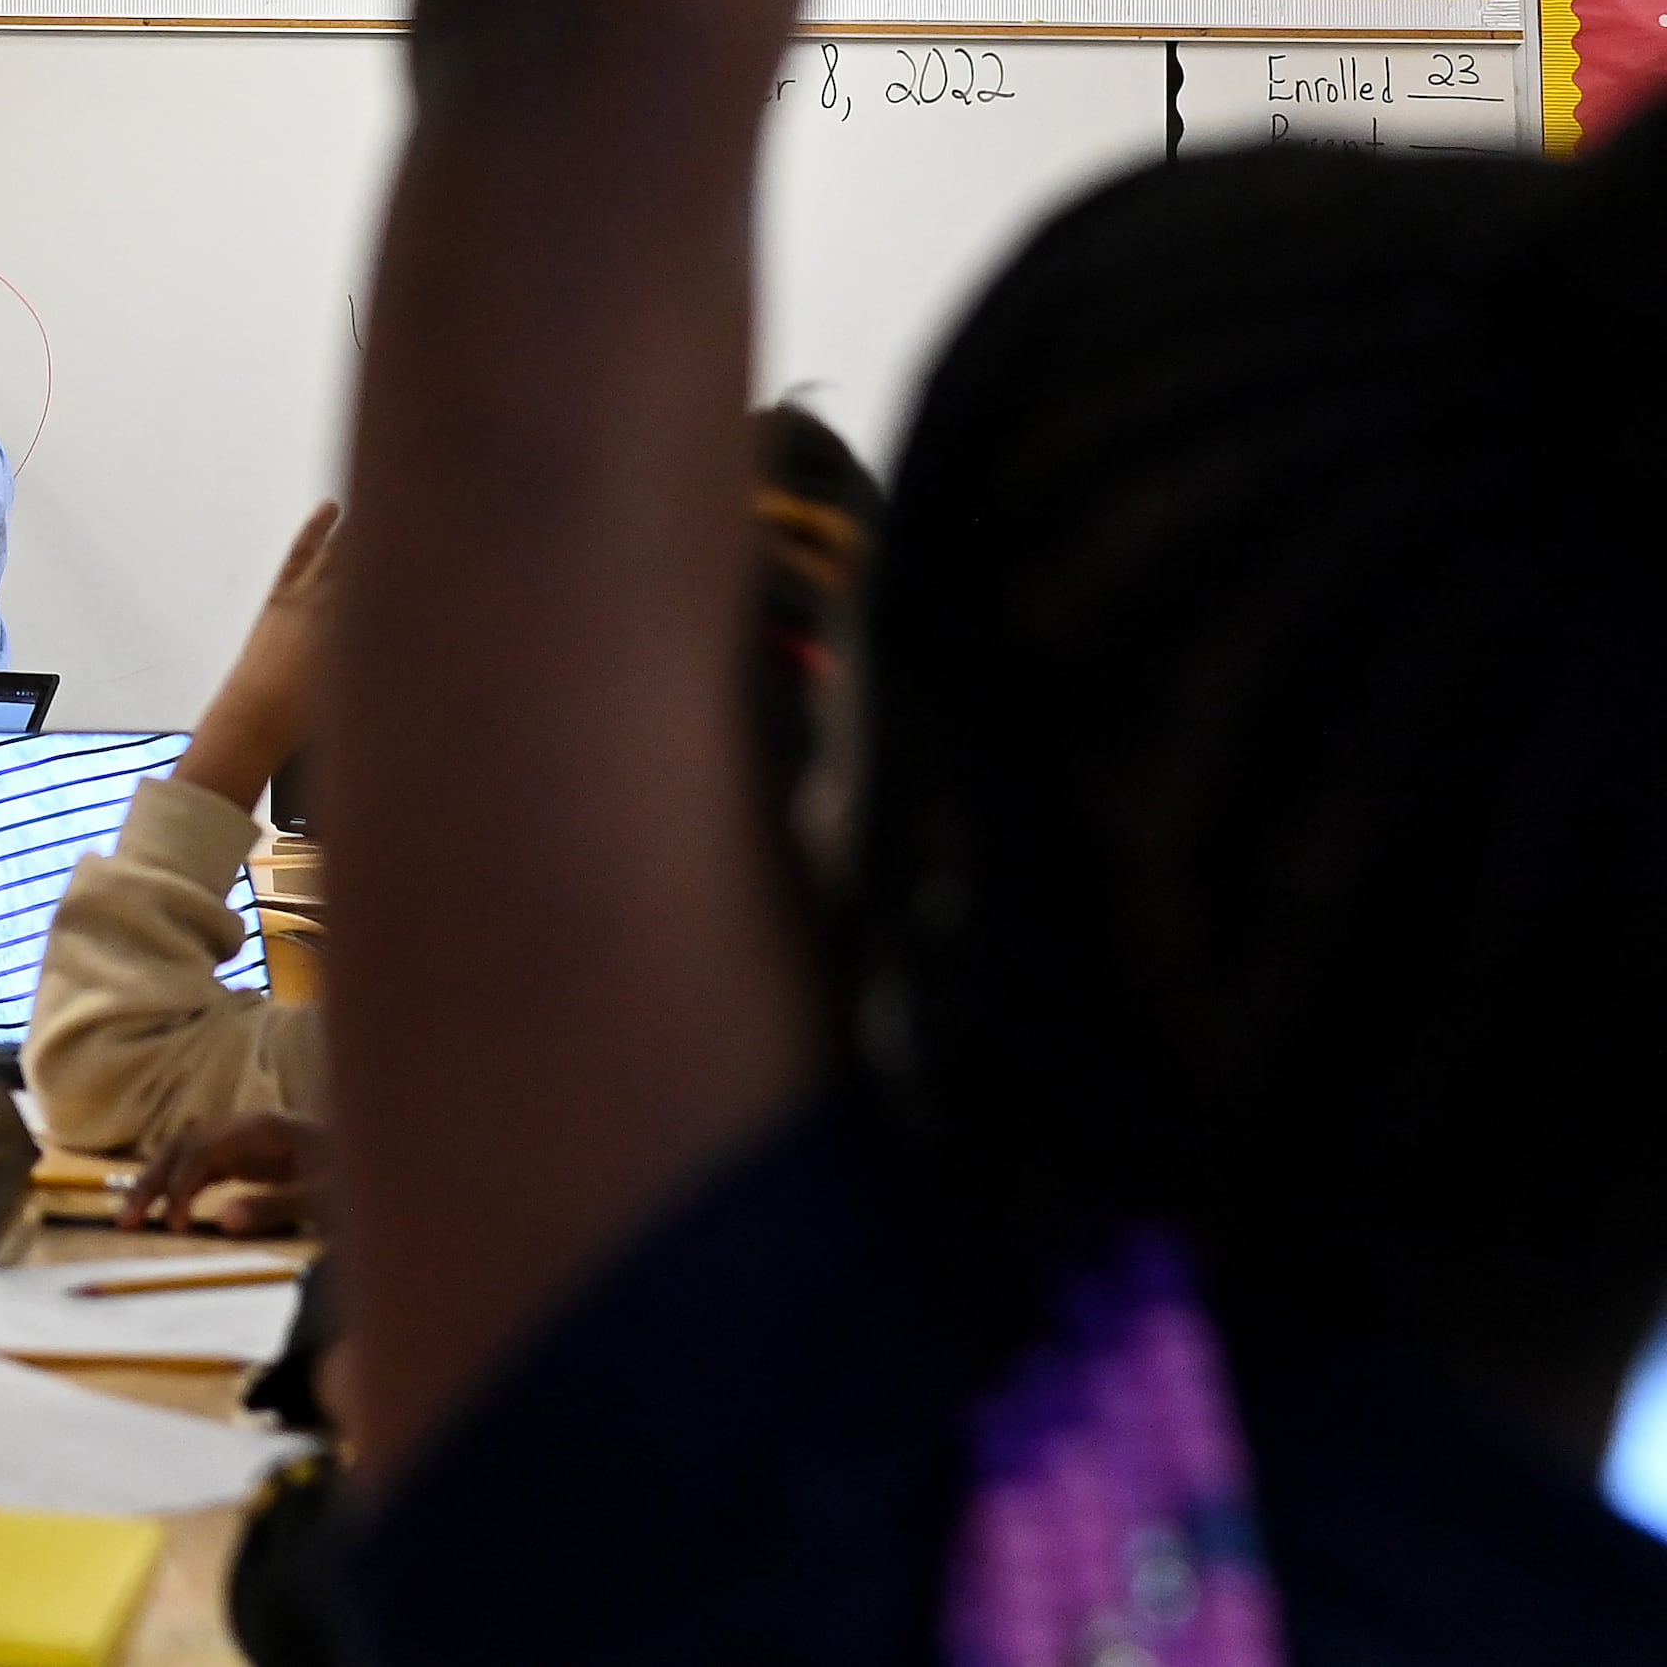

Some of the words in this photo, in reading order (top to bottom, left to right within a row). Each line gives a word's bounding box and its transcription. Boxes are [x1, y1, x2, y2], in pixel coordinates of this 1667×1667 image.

[821, 43, 851, 122] 8,
[886, 48, 1015, 106] 2022
[1268, 55, 1394, 103] Enrolled
[1428, 54, 1480, 86] 23
